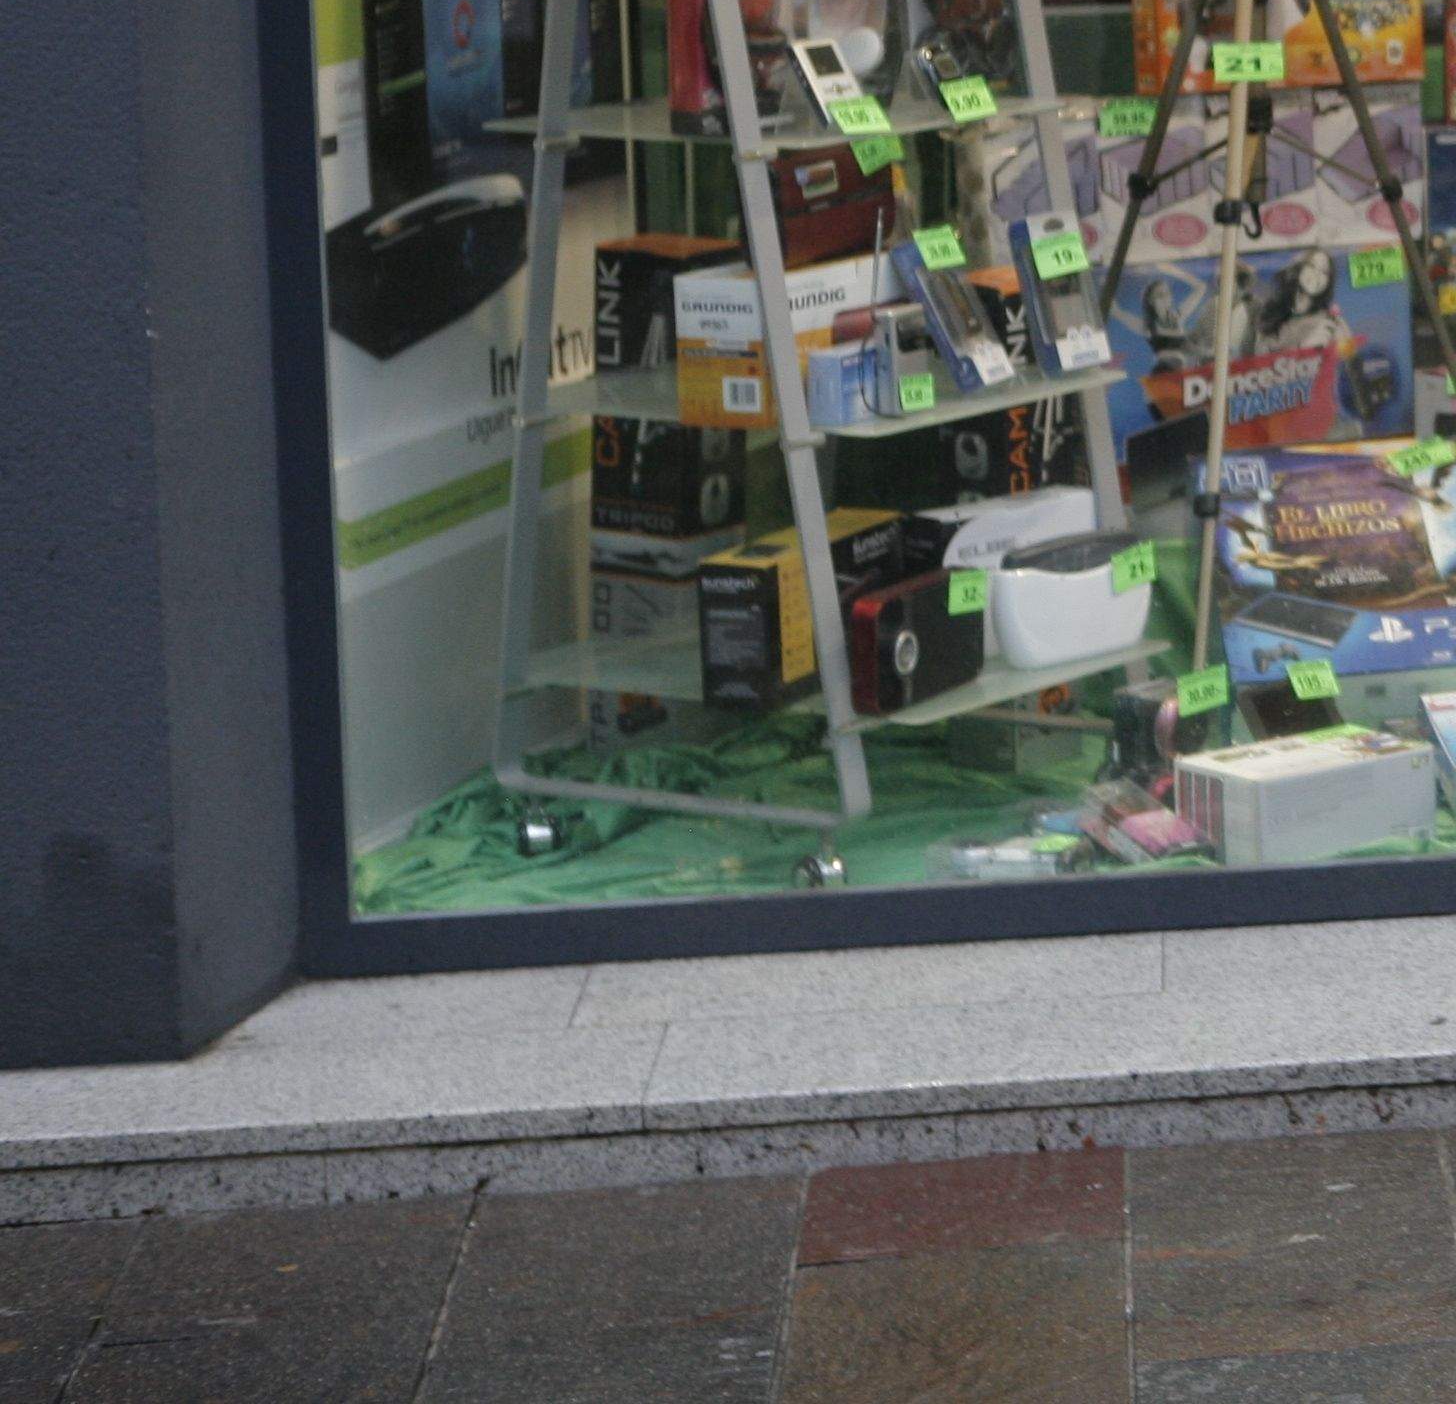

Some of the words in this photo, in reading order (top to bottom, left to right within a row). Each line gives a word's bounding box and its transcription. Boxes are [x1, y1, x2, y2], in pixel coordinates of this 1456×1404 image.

[1052, 249, 1074, 265] 19
[1356, 260, 1385, 281] 279
[1315, 499, 1388, 520] LIBRO
[1129, 562, 1148, 580] 21
